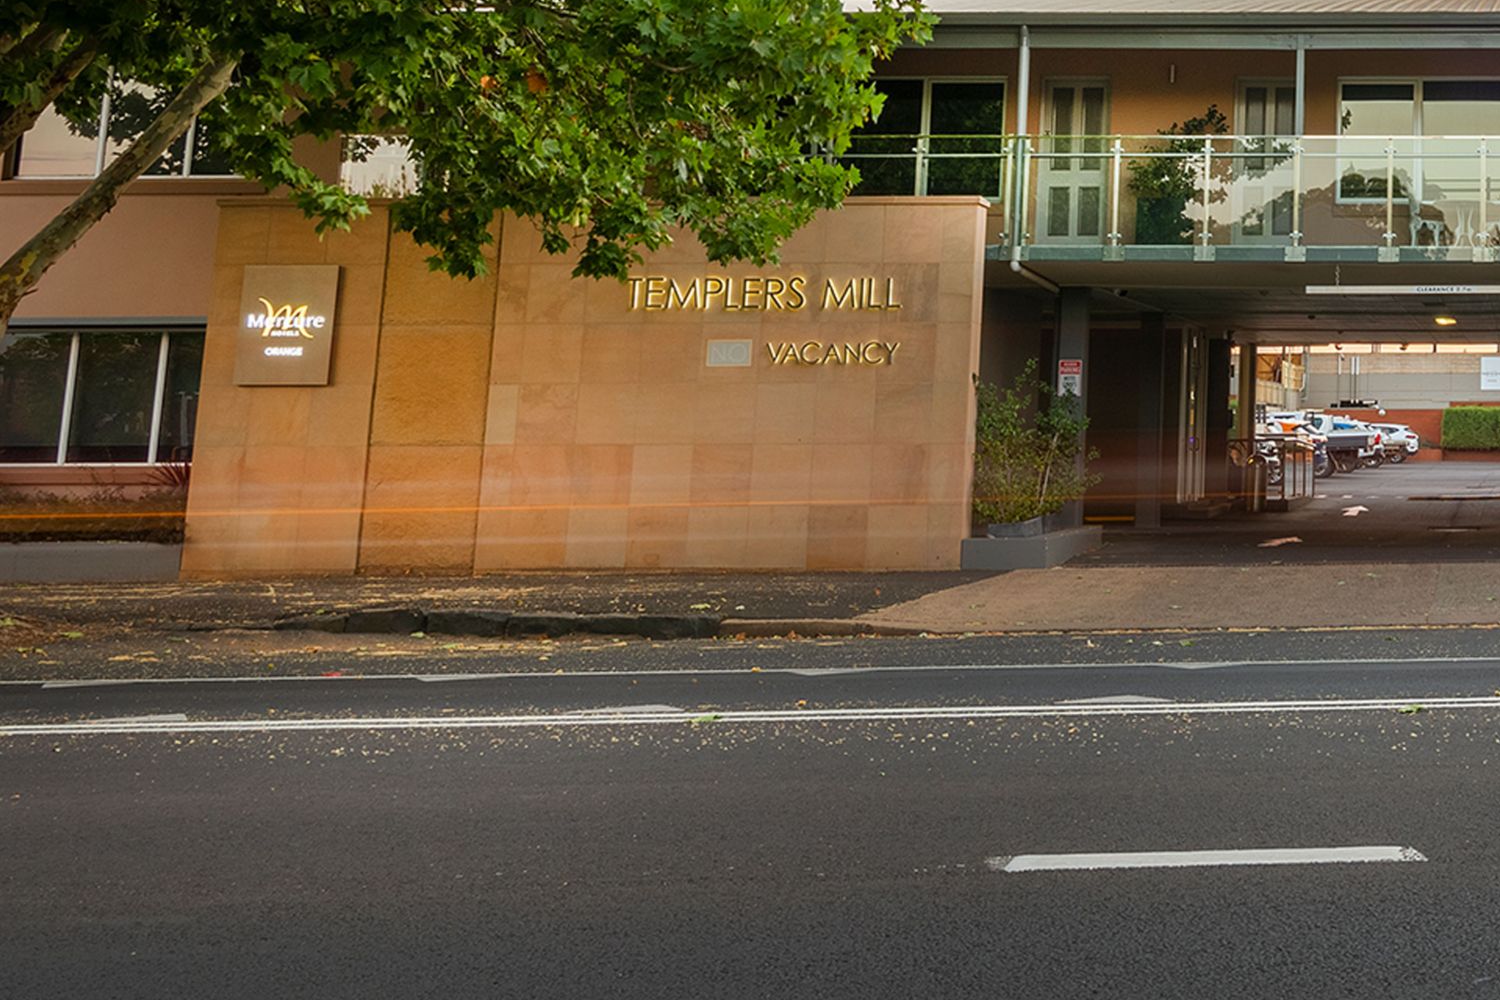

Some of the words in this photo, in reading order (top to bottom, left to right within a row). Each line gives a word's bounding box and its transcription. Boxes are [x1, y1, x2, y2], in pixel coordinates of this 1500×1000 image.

[627, 275, 807, 311] TEMPLERS
[821, 276, 903, 311] MILL
[246, 313, 326, 329] Mercure
[264, 346, 304, 356] ORANGE
[711, 343, 748, 363] NO
[766, 340, 901, 366] VACANCY
